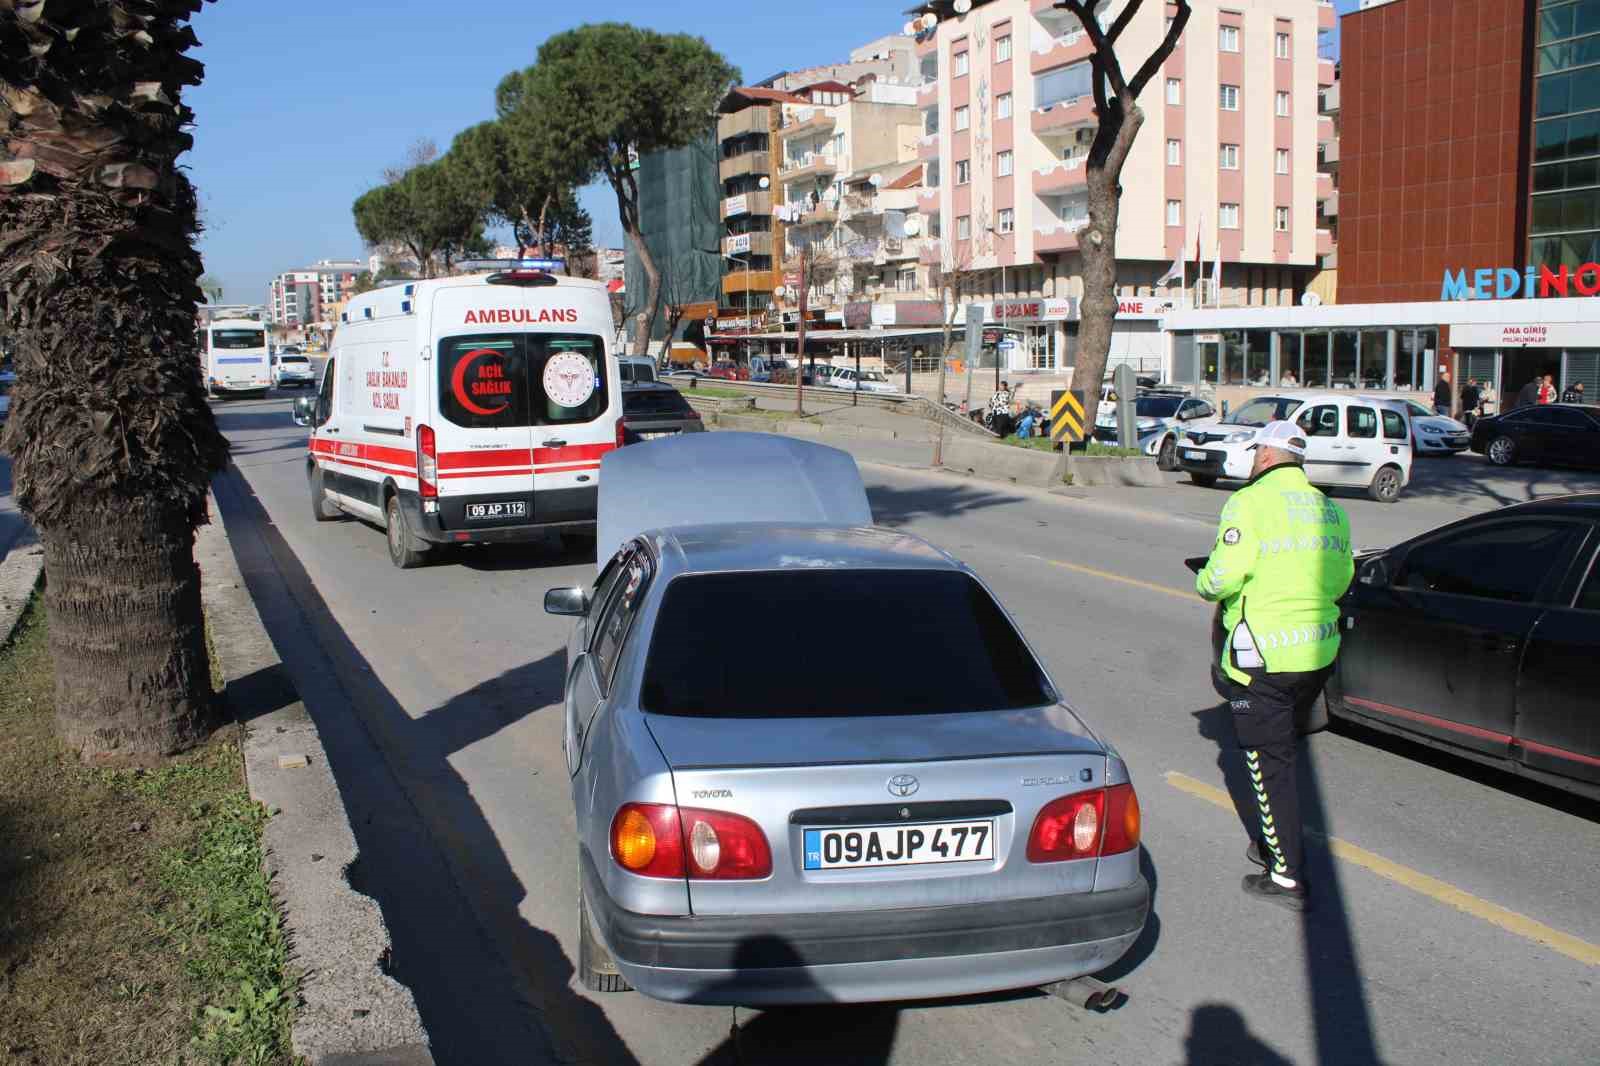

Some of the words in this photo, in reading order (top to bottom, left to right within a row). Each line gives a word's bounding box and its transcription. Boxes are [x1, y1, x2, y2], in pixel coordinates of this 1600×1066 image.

[464, 308, 577, 324] AMBULANS
[471, 379, 513, 395] SAĞLIK
[472, 505, 485, 516] 09
[488, 504, 502, 515] AP
[506, 502, 524, 514] 112
[691, 789, 733, 799] TOYOTA
[807, 851, 820, 862] TR
